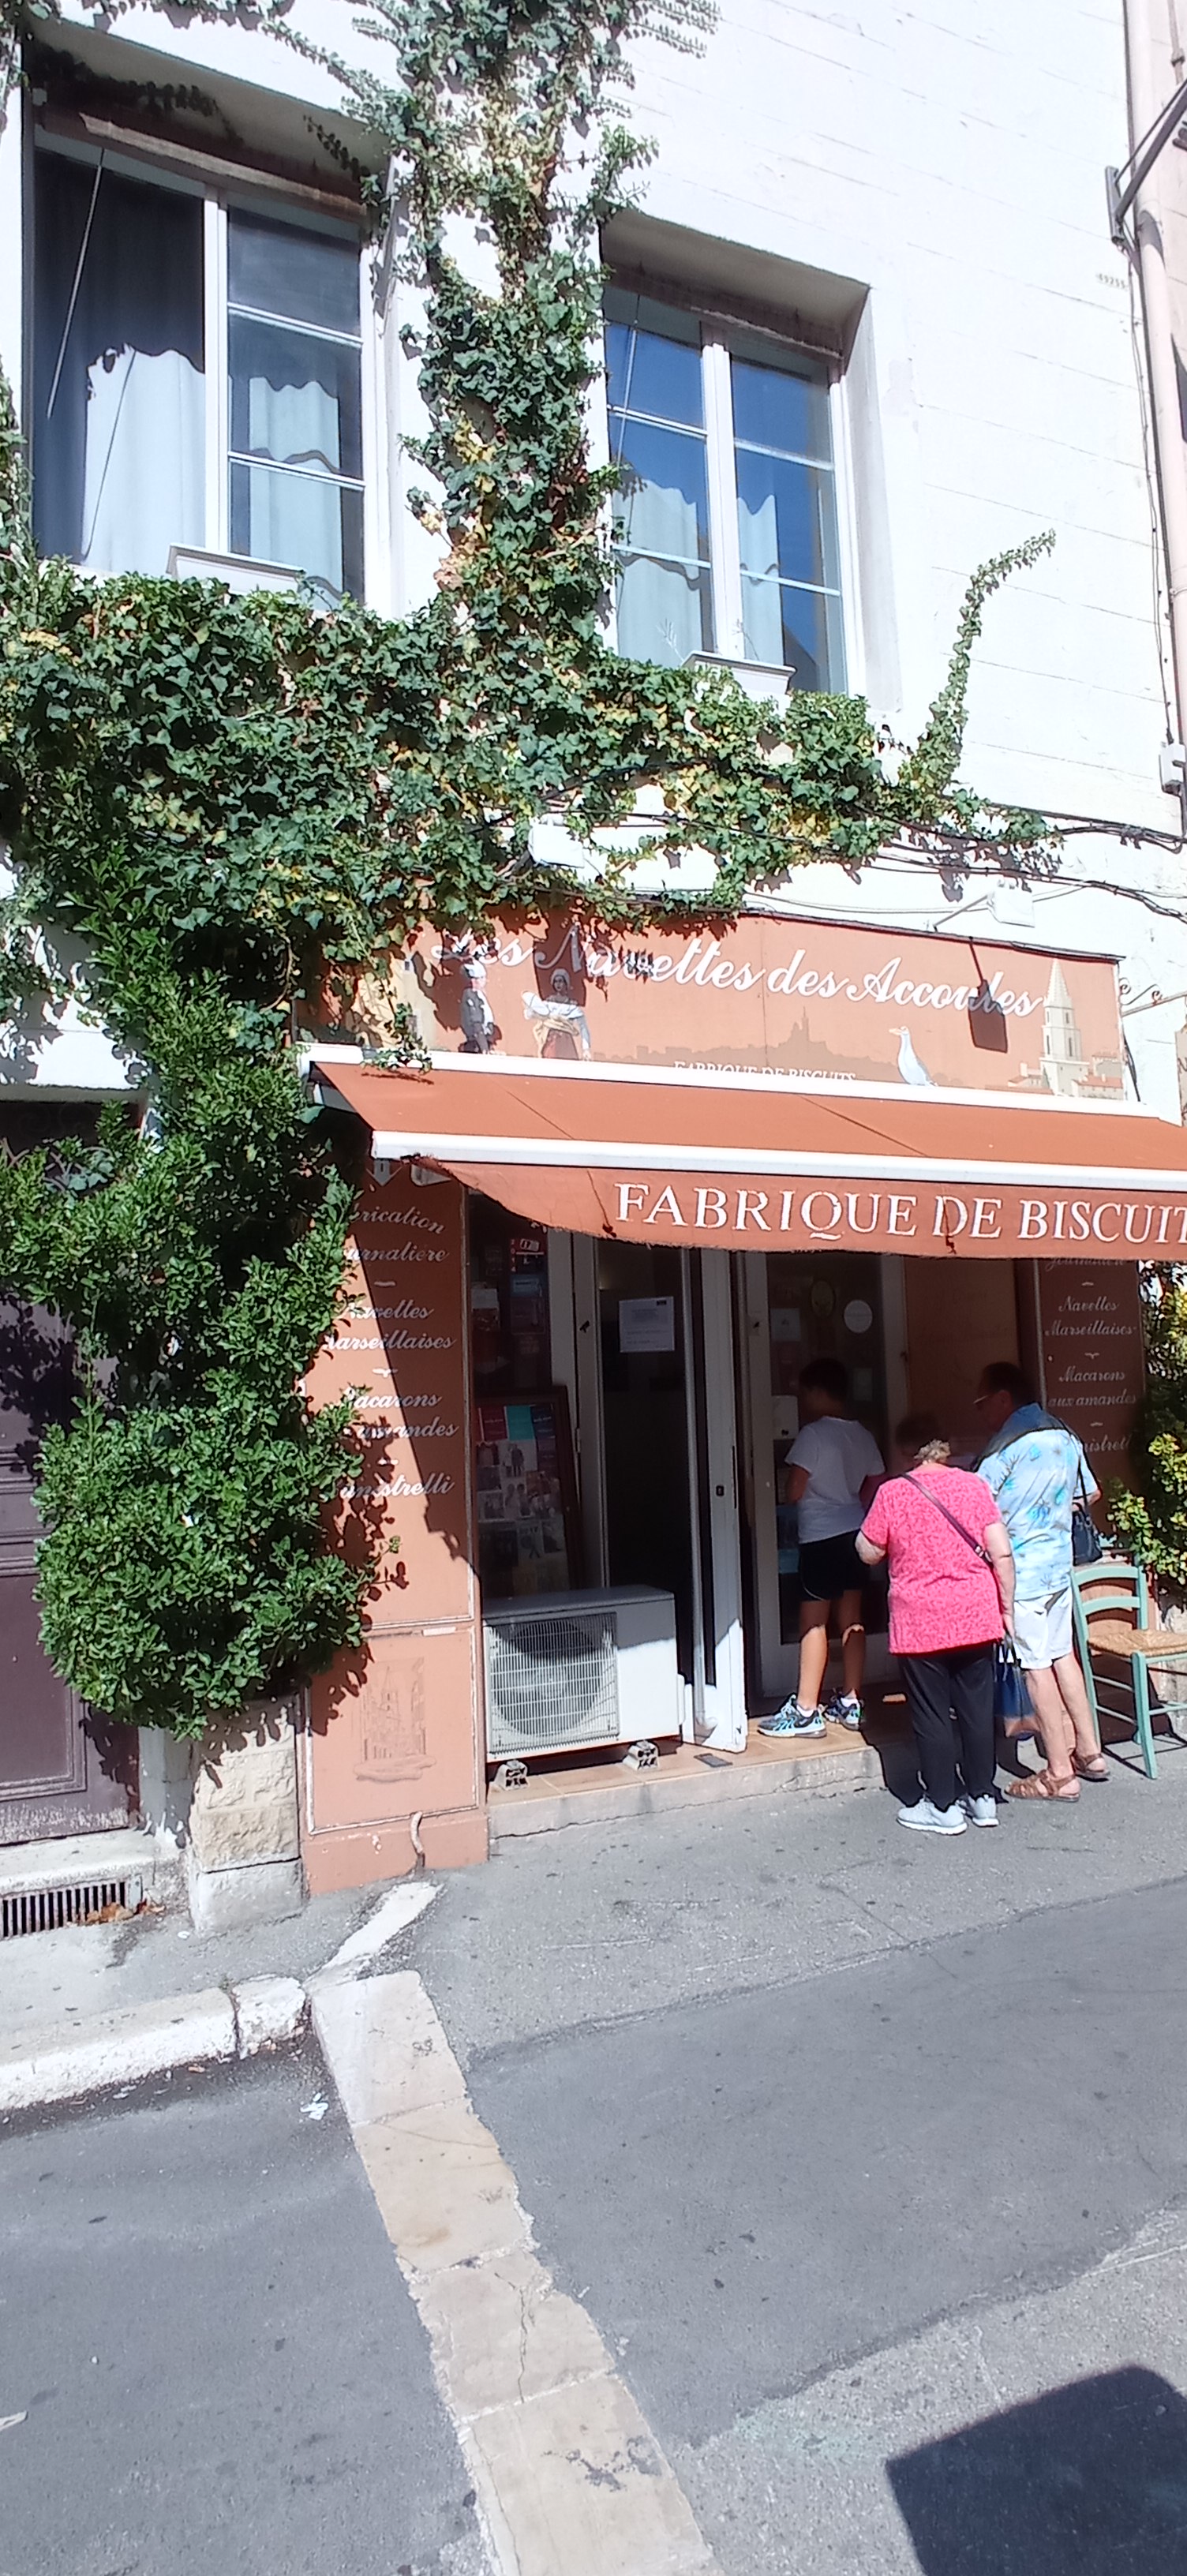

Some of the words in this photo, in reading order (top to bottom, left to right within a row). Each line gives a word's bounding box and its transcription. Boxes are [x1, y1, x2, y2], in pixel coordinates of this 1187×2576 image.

[534, 923, 766, 991] Navettes
[767, 949, 849, 998] des
[847, 957, 1043, 1018] Accoules
[614, 1182, 917, 1240] FABRIQUE
[932, 1195, 1002, 1239] DE
[1058, 1295, 1119, 1312] Navettes
[1044, 1320, 1136, 1336] Marseillaises
[1058, 1365, 1125, 1382] Macarons
[354, 1395, 442, 1409] acarons
